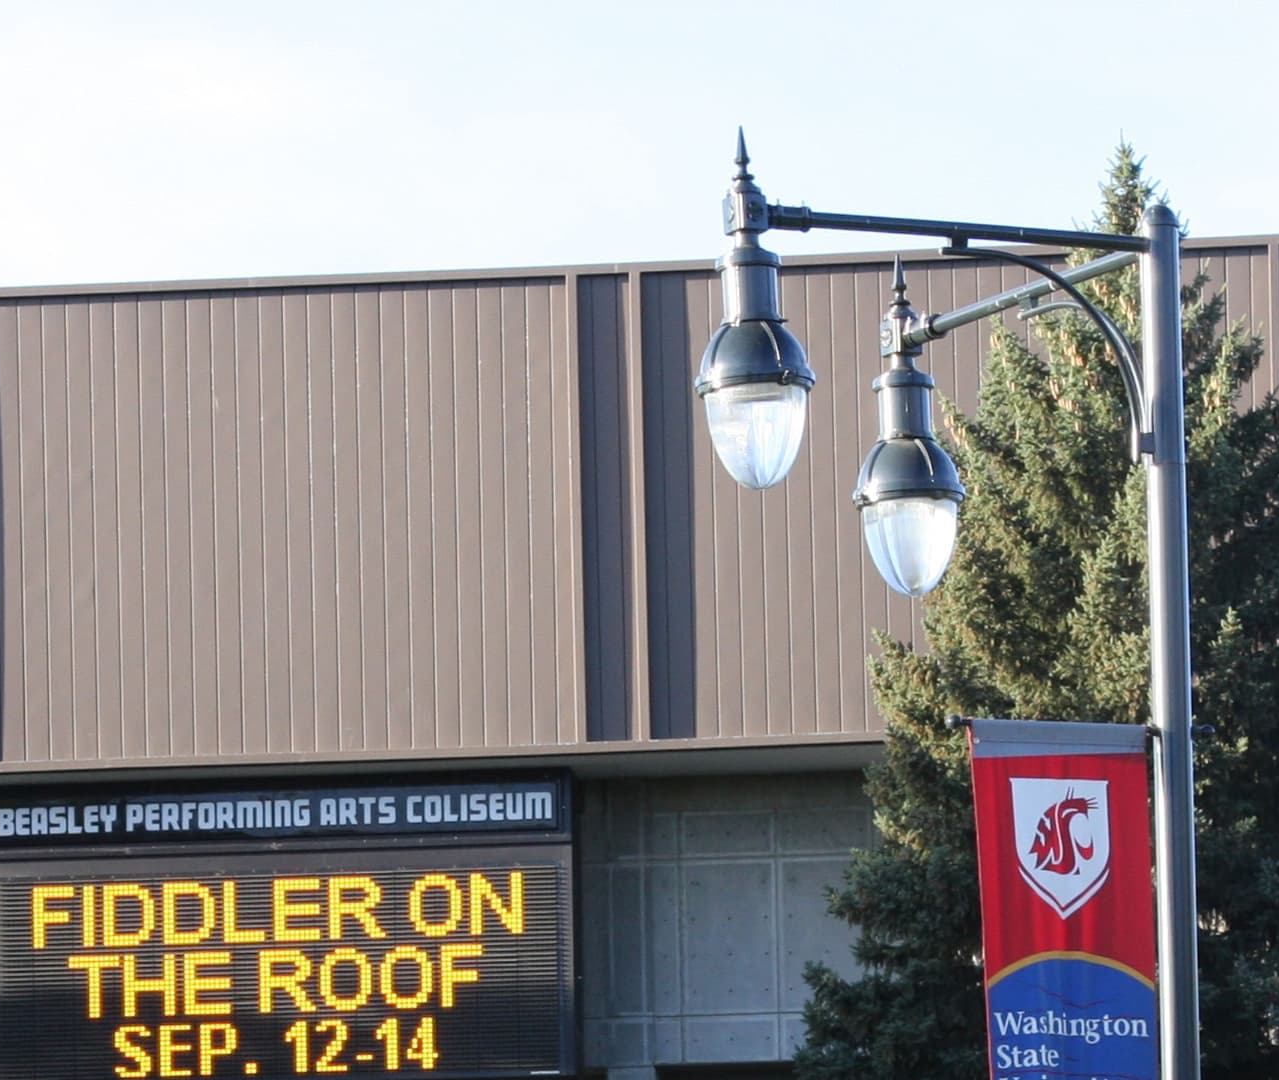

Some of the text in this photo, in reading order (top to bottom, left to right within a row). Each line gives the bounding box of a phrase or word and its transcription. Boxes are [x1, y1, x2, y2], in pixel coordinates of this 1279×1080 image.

[126, 798, 310, 834] PERFORMING
[320, 796, 397, 827] ARTS
[406, 791, 553, 825] COLISEUM
[31, 871, 524, 950] FIDDLER ON
[68, 943, 483, 1019] THE ROOF
[114, 1017, 439, 1078] SEP. 12-14
[994, 1010, 1149, 1044] Washington
[996, 1044, 1060, 1069] State
